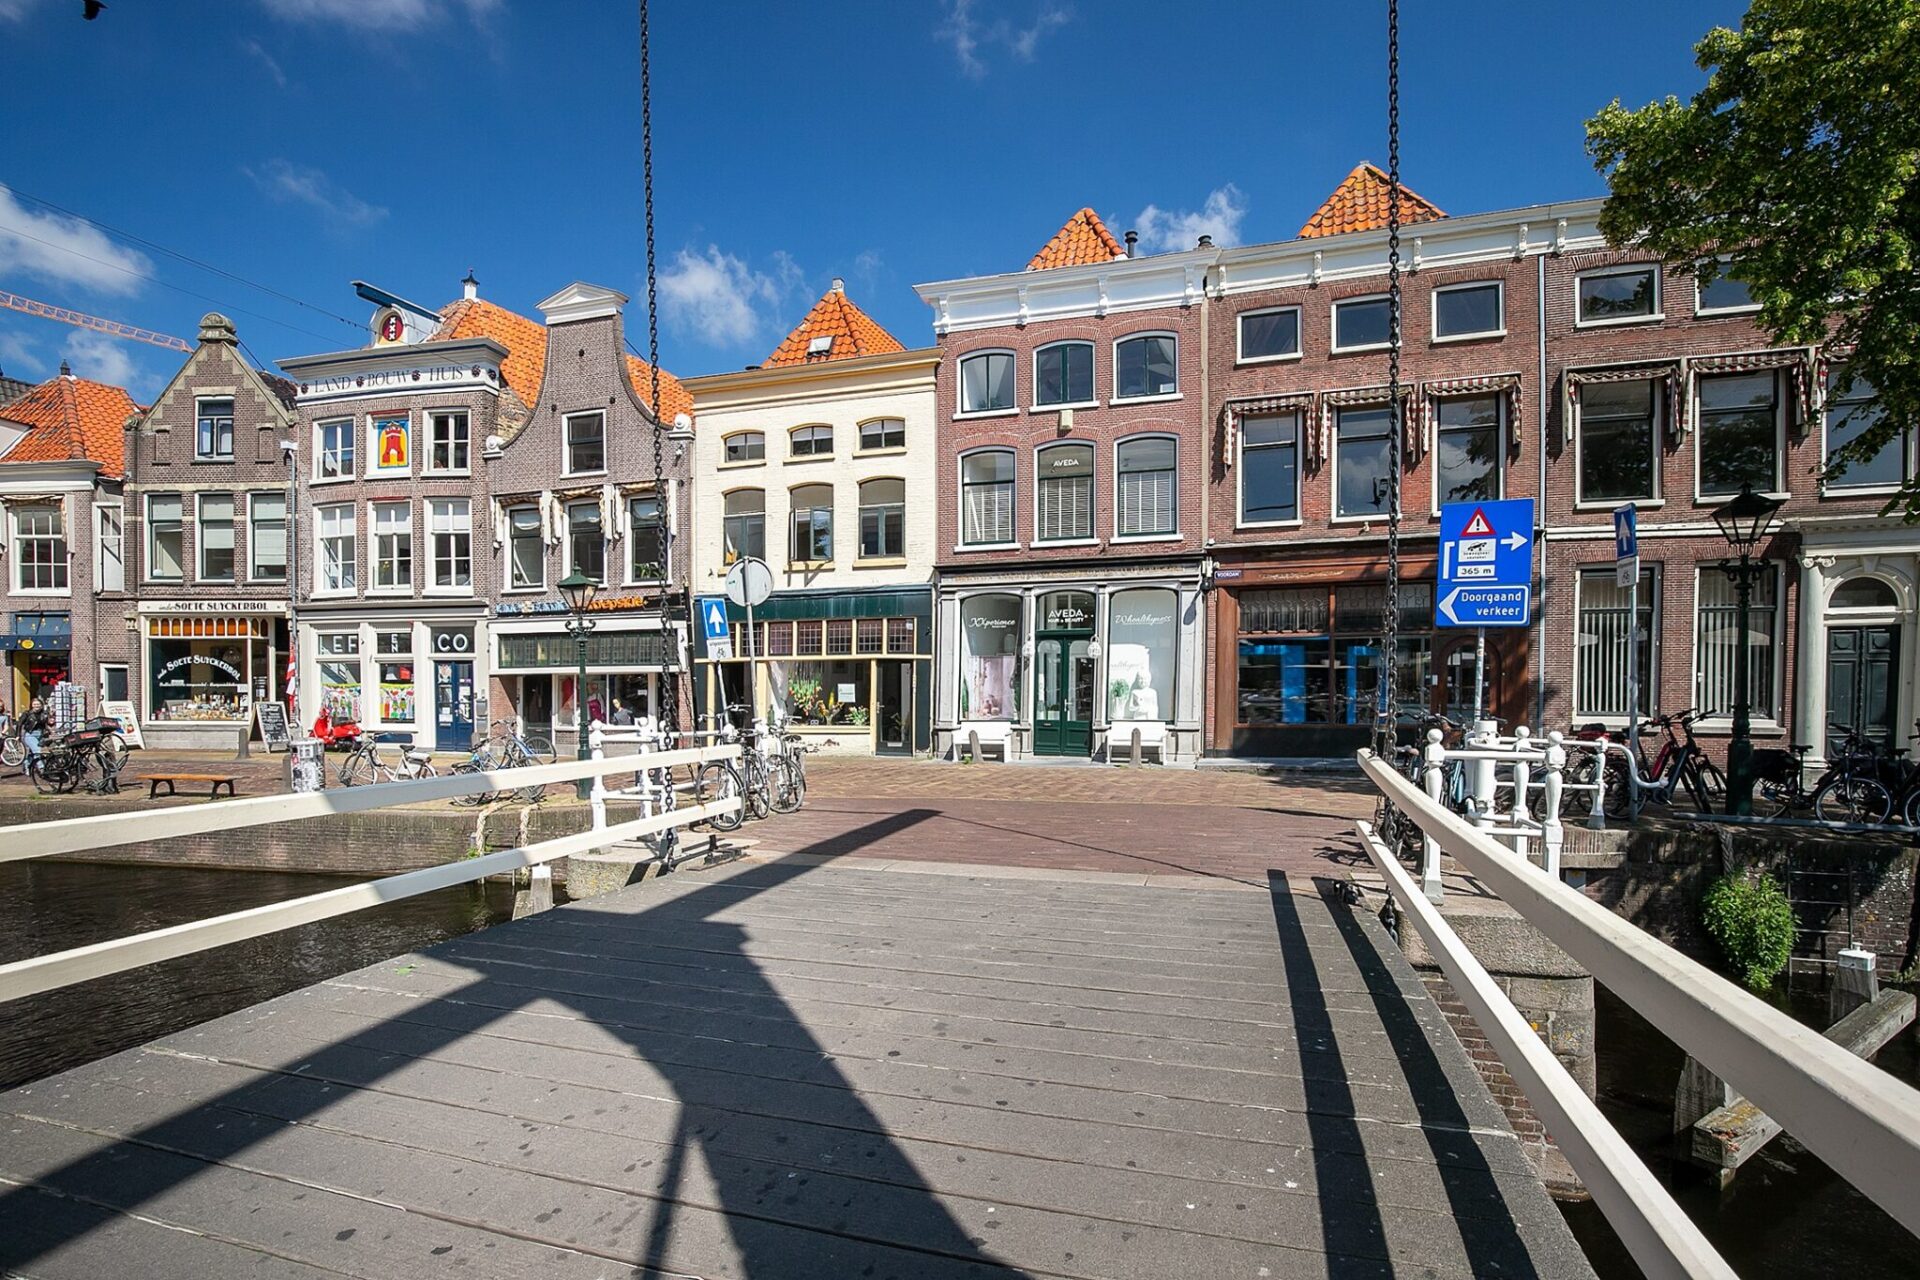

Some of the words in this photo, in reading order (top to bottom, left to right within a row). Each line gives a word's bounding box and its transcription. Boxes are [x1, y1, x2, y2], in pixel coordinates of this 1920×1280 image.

[314, 376, 351, 393] LAND
[367, 370, 410, 387] BOUW
[429, 366, 464, 381] HUIS
[1053, 459, 1079, 467] AVEDA
[1461, 567, 1480, 575] 365
[1461, 591, 1522, 604] Doorgaand
[1048, 608, 1084, 618] AVEDA
[1476, 606, 1521, 616] verkeer
[391, 633, 399, 653] EN
[437, 633, 468, 652] CO
